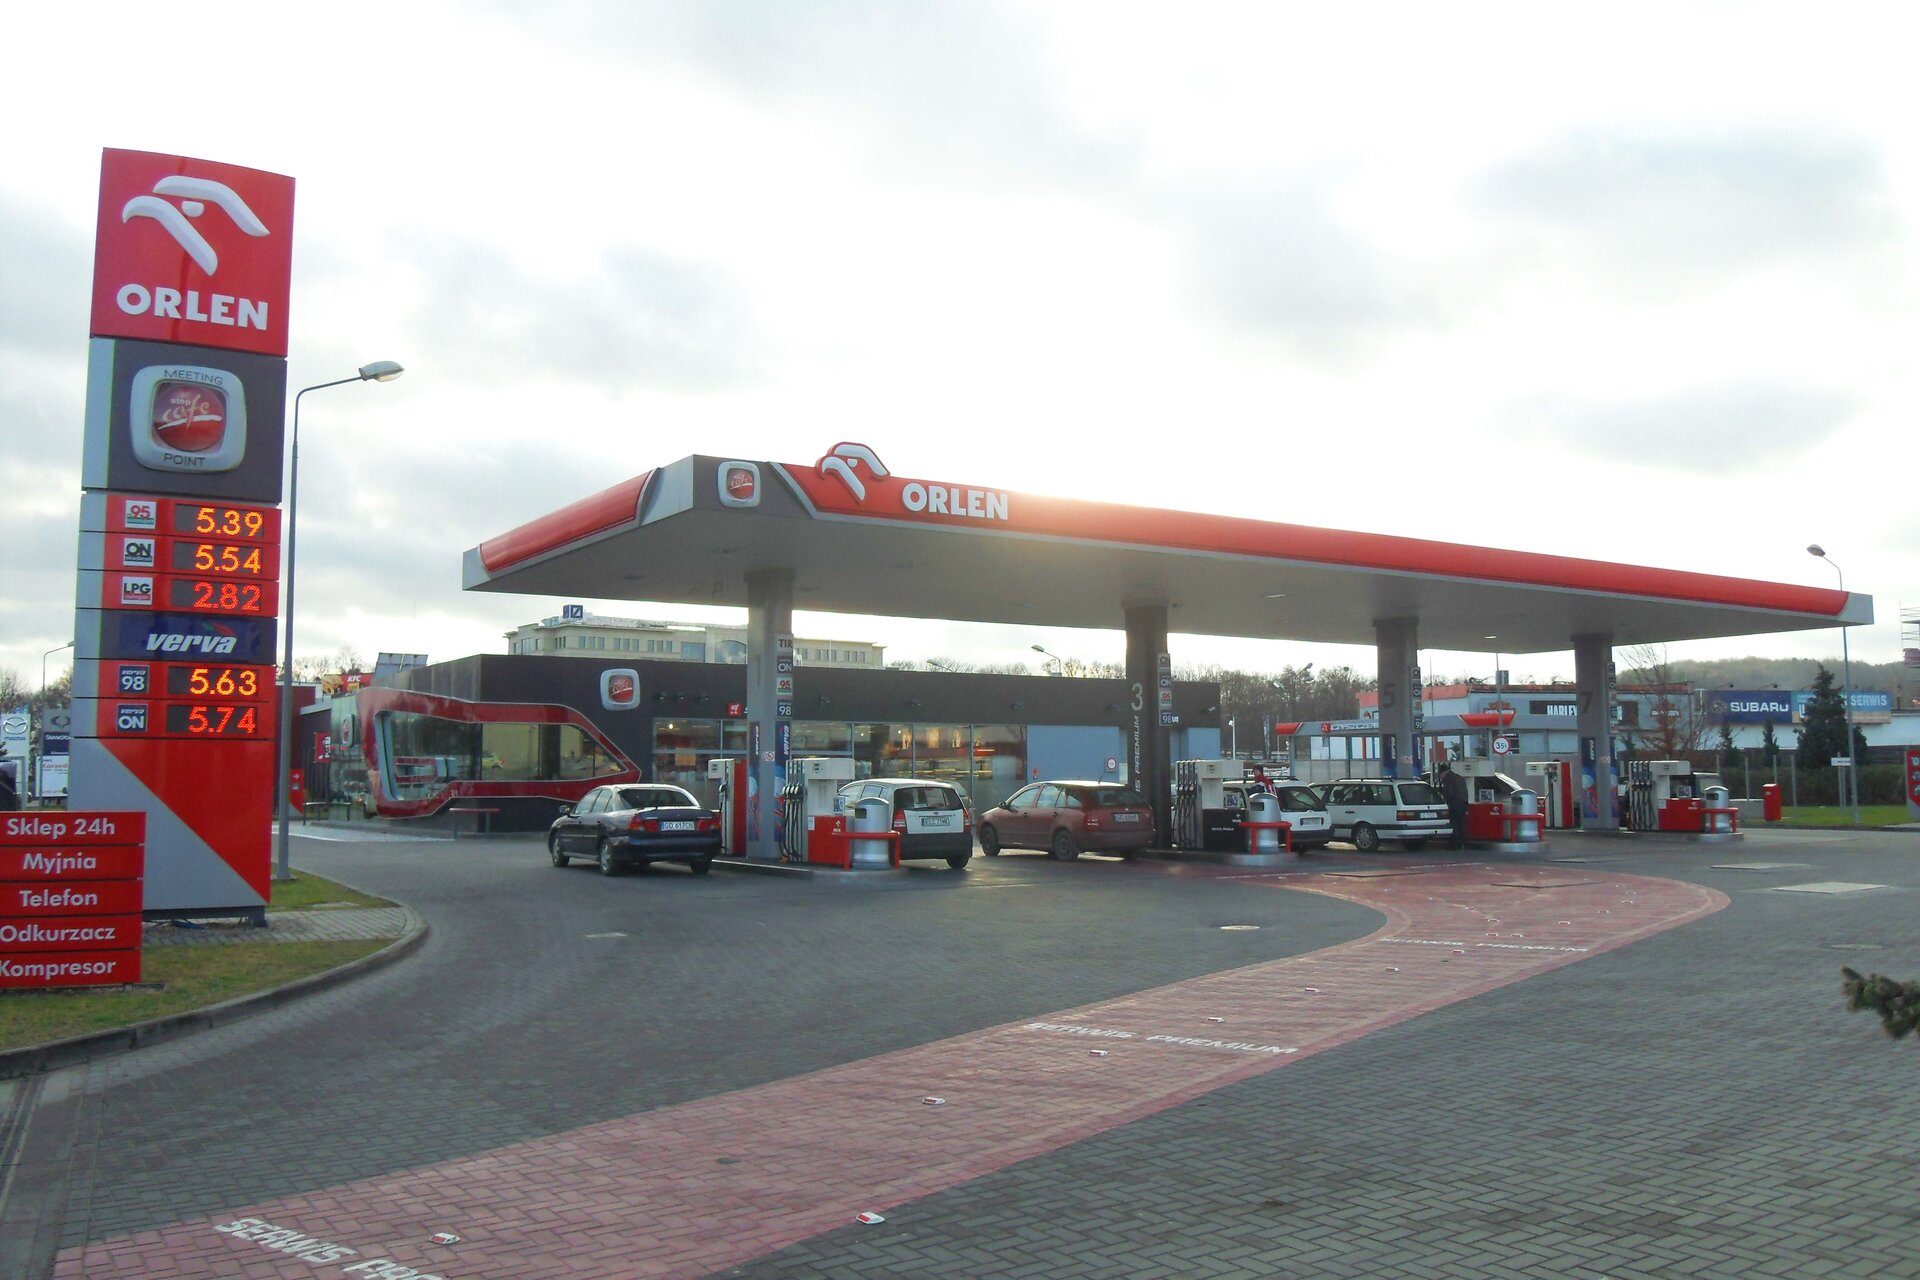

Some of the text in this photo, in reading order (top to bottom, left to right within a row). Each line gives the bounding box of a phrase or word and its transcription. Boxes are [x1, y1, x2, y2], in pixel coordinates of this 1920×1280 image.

[117, 283, 269, 331] ORLEN
[164, 369, 223, 386] MEETING
[163, 452, 205, 467] POINT
[902, 482, 1008, 520] ORLEN
[130, 505, 151, 519] 95
[197, 507, 264, 537] 5.39
[126, 542, 152, 558] ON
[195, 544, 261, 574] 5.54
[123, 582, 151, 594] LPG
[193, 581, 261, 612] 2.82
[146, 633, 237, 654] verva
[778, 638, 793, 649] TIR
[778, 662, 793, 672] ON
[121, 675, 145, 691] 98
[190, 668, 257, 696] 5.63
[1131, 682, 1144, 712] 3
[1730, 702, 1789, 712] SUBARU
[1850, 694, 1887, 707] SERWIS
[188, 705, 257, 734] 5.74
[779, 705, 793, 716] 98
[118, 715, 145, 729] ON
[7, 817, 116, 839] Sklep 24h
[23, 852, 97, 874] Myjnia
[19, 888, 98, 908] Telefon
[0, 924, 116, 943] Odkurzacz
[0, 959, 117, 980] Kompresor
[1024, 1022, 1299, 1054] SERWIS PREMIUM
[213, 1217, 358, 1264] SERWIS
